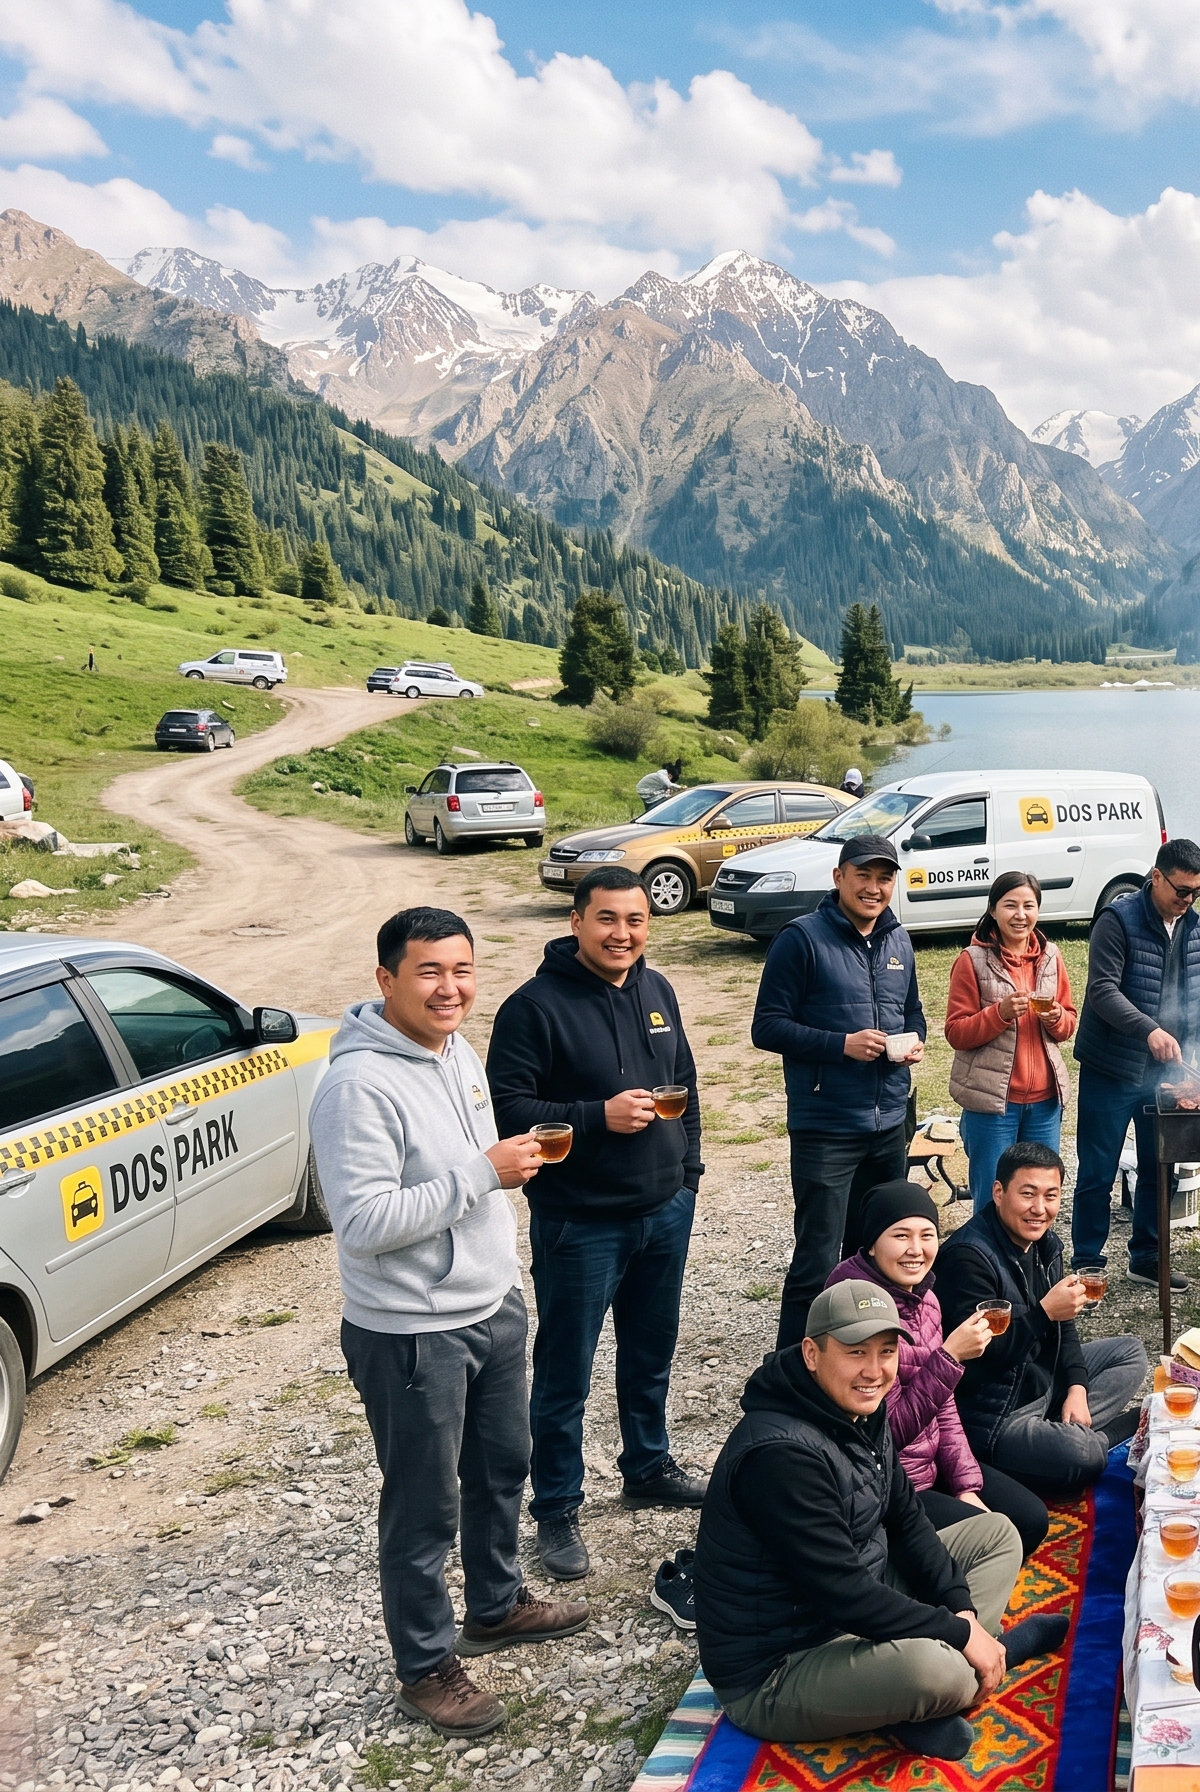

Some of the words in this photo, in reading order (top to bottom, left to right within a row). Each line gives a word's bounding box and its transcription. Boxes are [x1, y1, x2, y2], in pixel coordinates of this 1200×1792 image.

[1056, 803, 1092, 823] DOS
[1096, 801, 1143, 821] PARK
[928, 870, 954, 884] DOS
[957, 867, 990, 882] PARK
[108, 1145, 168, 1214] DOS
[173, 1110, 239, 1183] PARK
